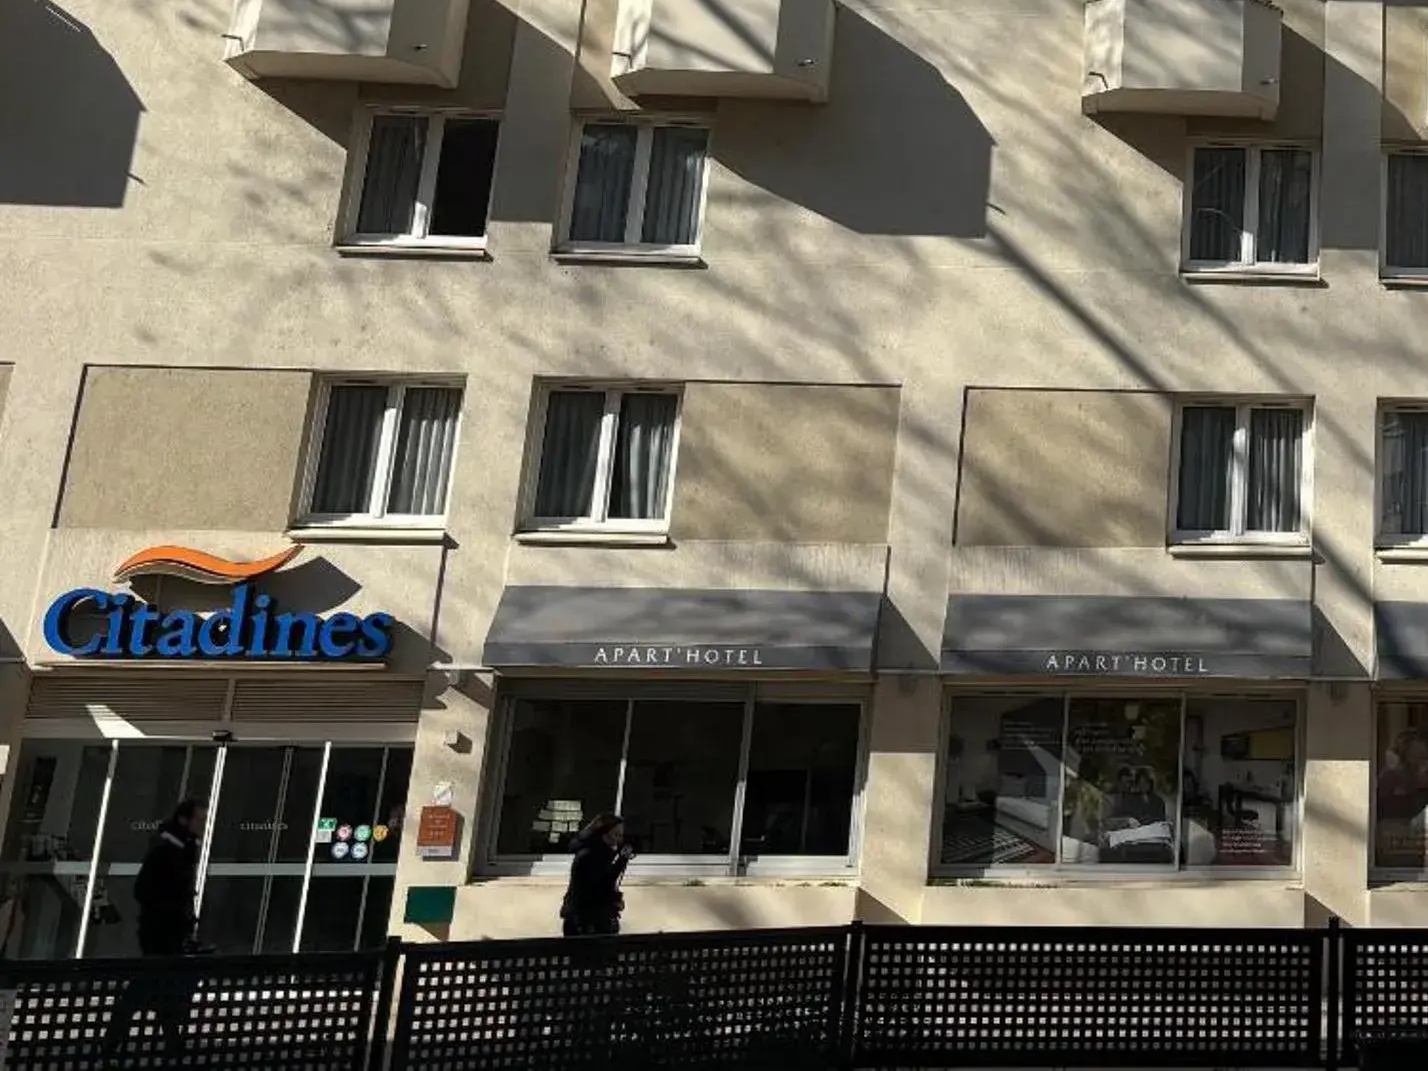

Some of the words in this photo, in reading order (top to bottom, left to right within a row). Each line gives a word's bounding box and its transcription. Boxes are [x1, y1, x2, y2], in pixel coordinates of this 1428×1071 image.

[43, 582, 393, 658] Citadines
[594, 646, 762, 665] APART'HOTEL
[1046, 654, 1208, 672] APART'HOTEL
